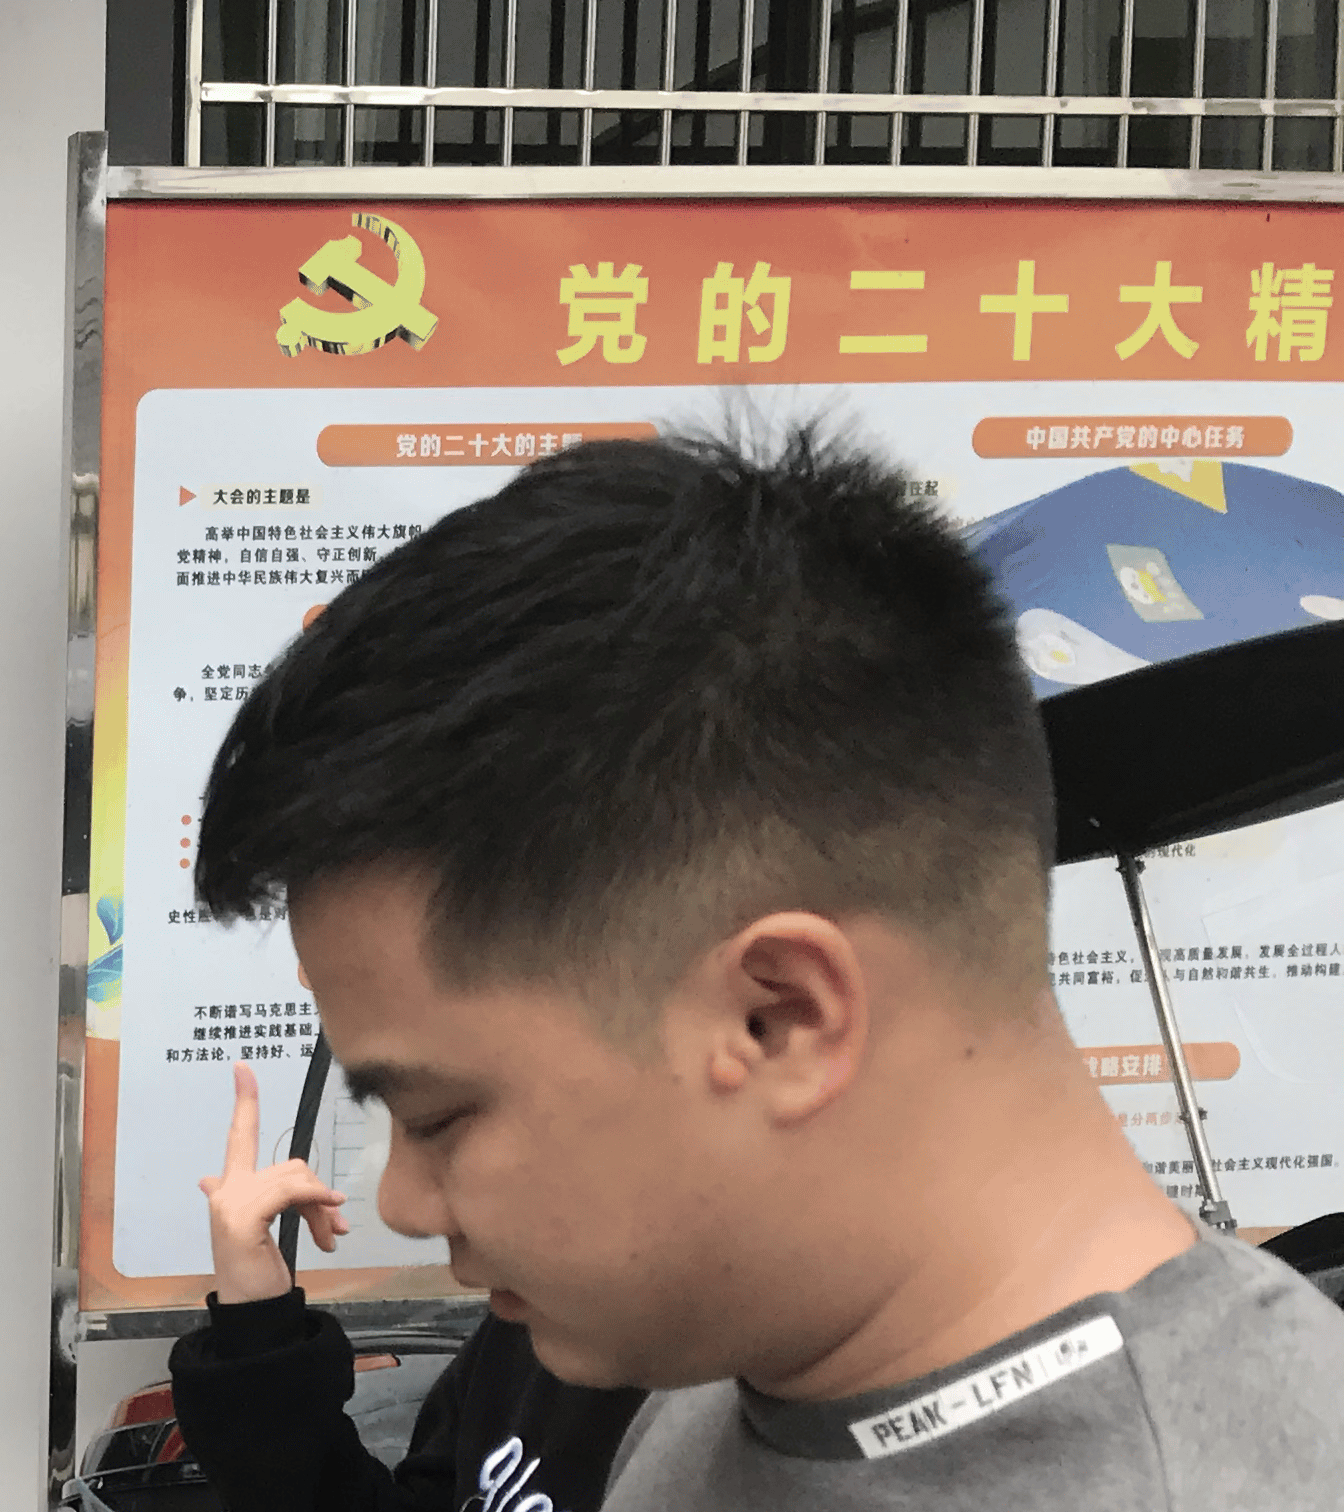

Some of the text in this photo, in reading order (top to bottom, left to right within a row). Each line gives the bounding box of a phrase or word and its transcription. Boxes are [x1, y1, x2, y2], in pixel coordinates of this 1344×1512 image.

[556, 257, 1336, 365] 党的二十大精
[1026, 425, 1245, 449] 中国共产党的中心任务
[212, 487, 311, 506] 大会的主题是
[176, 569, 367, 586] 面推进中华民族伟大复兴而
[173, 686, 254, 702] 争，坚定历
[193, 1002, 319, 1020] 不断谱写马克思主
